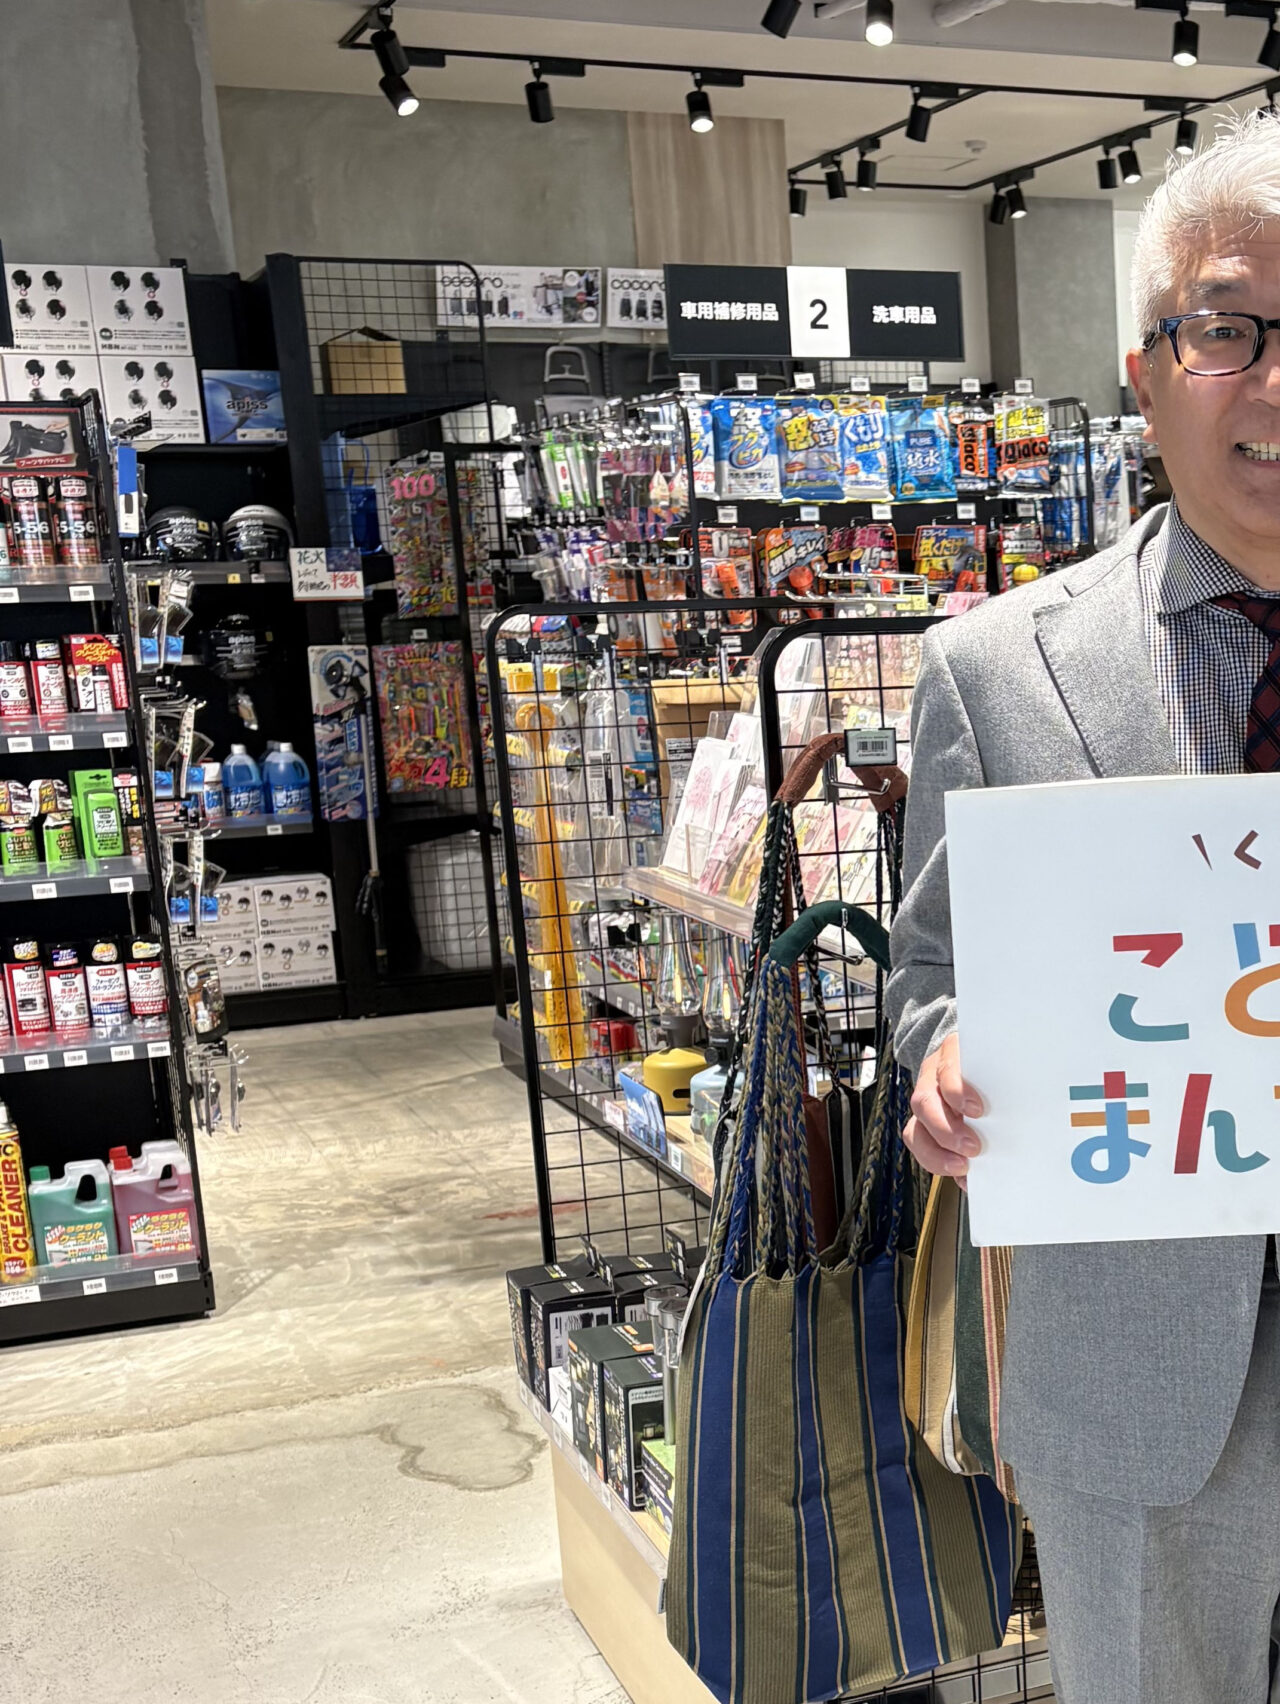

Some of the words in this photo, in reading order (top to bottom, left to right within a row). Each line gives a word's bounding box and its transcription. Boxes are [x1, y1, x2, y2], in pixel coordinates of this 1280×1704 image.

[680, 301, 779, 321] 車用補修用品
[809, 298, 829, 330] 2
[872, 305, 937, 324] 洗車用品
[14, 521, 48, 534] 5-56
[59, 521, 96, 534] 5-56
[2, 1159, 30, 1252] CLEANER
